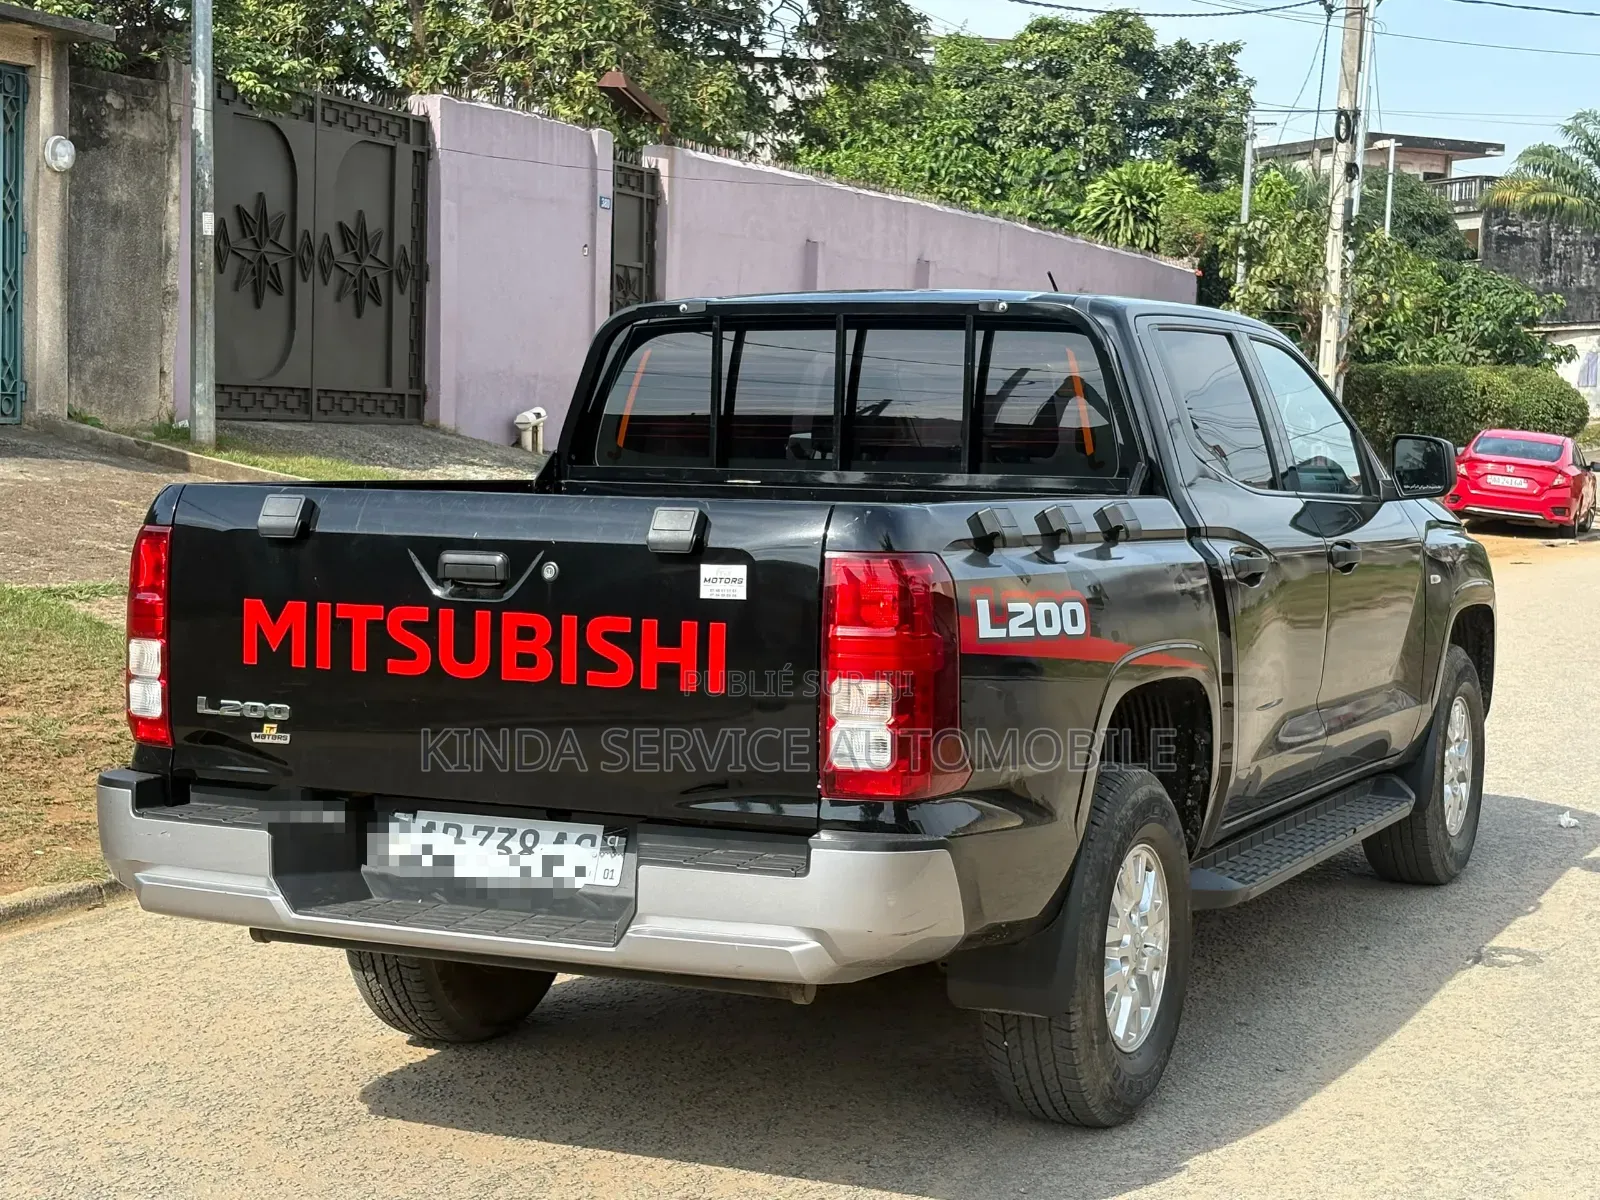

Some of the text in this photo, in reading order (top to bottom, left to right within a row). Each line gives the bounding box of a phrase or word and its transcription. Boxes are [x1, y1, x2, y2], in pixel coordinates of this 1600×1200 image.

[703, 577, 744, 585] MOTORS
[976, 599, 1086, 639] L200
[242, 598, 727, 694] MITSUBISHI
[197, 695, 290, 720] L200
[254, 733, 289, 741] MOTORS
[607, 835, 620, 847] CI
[603, 868, 615, 880] 01
